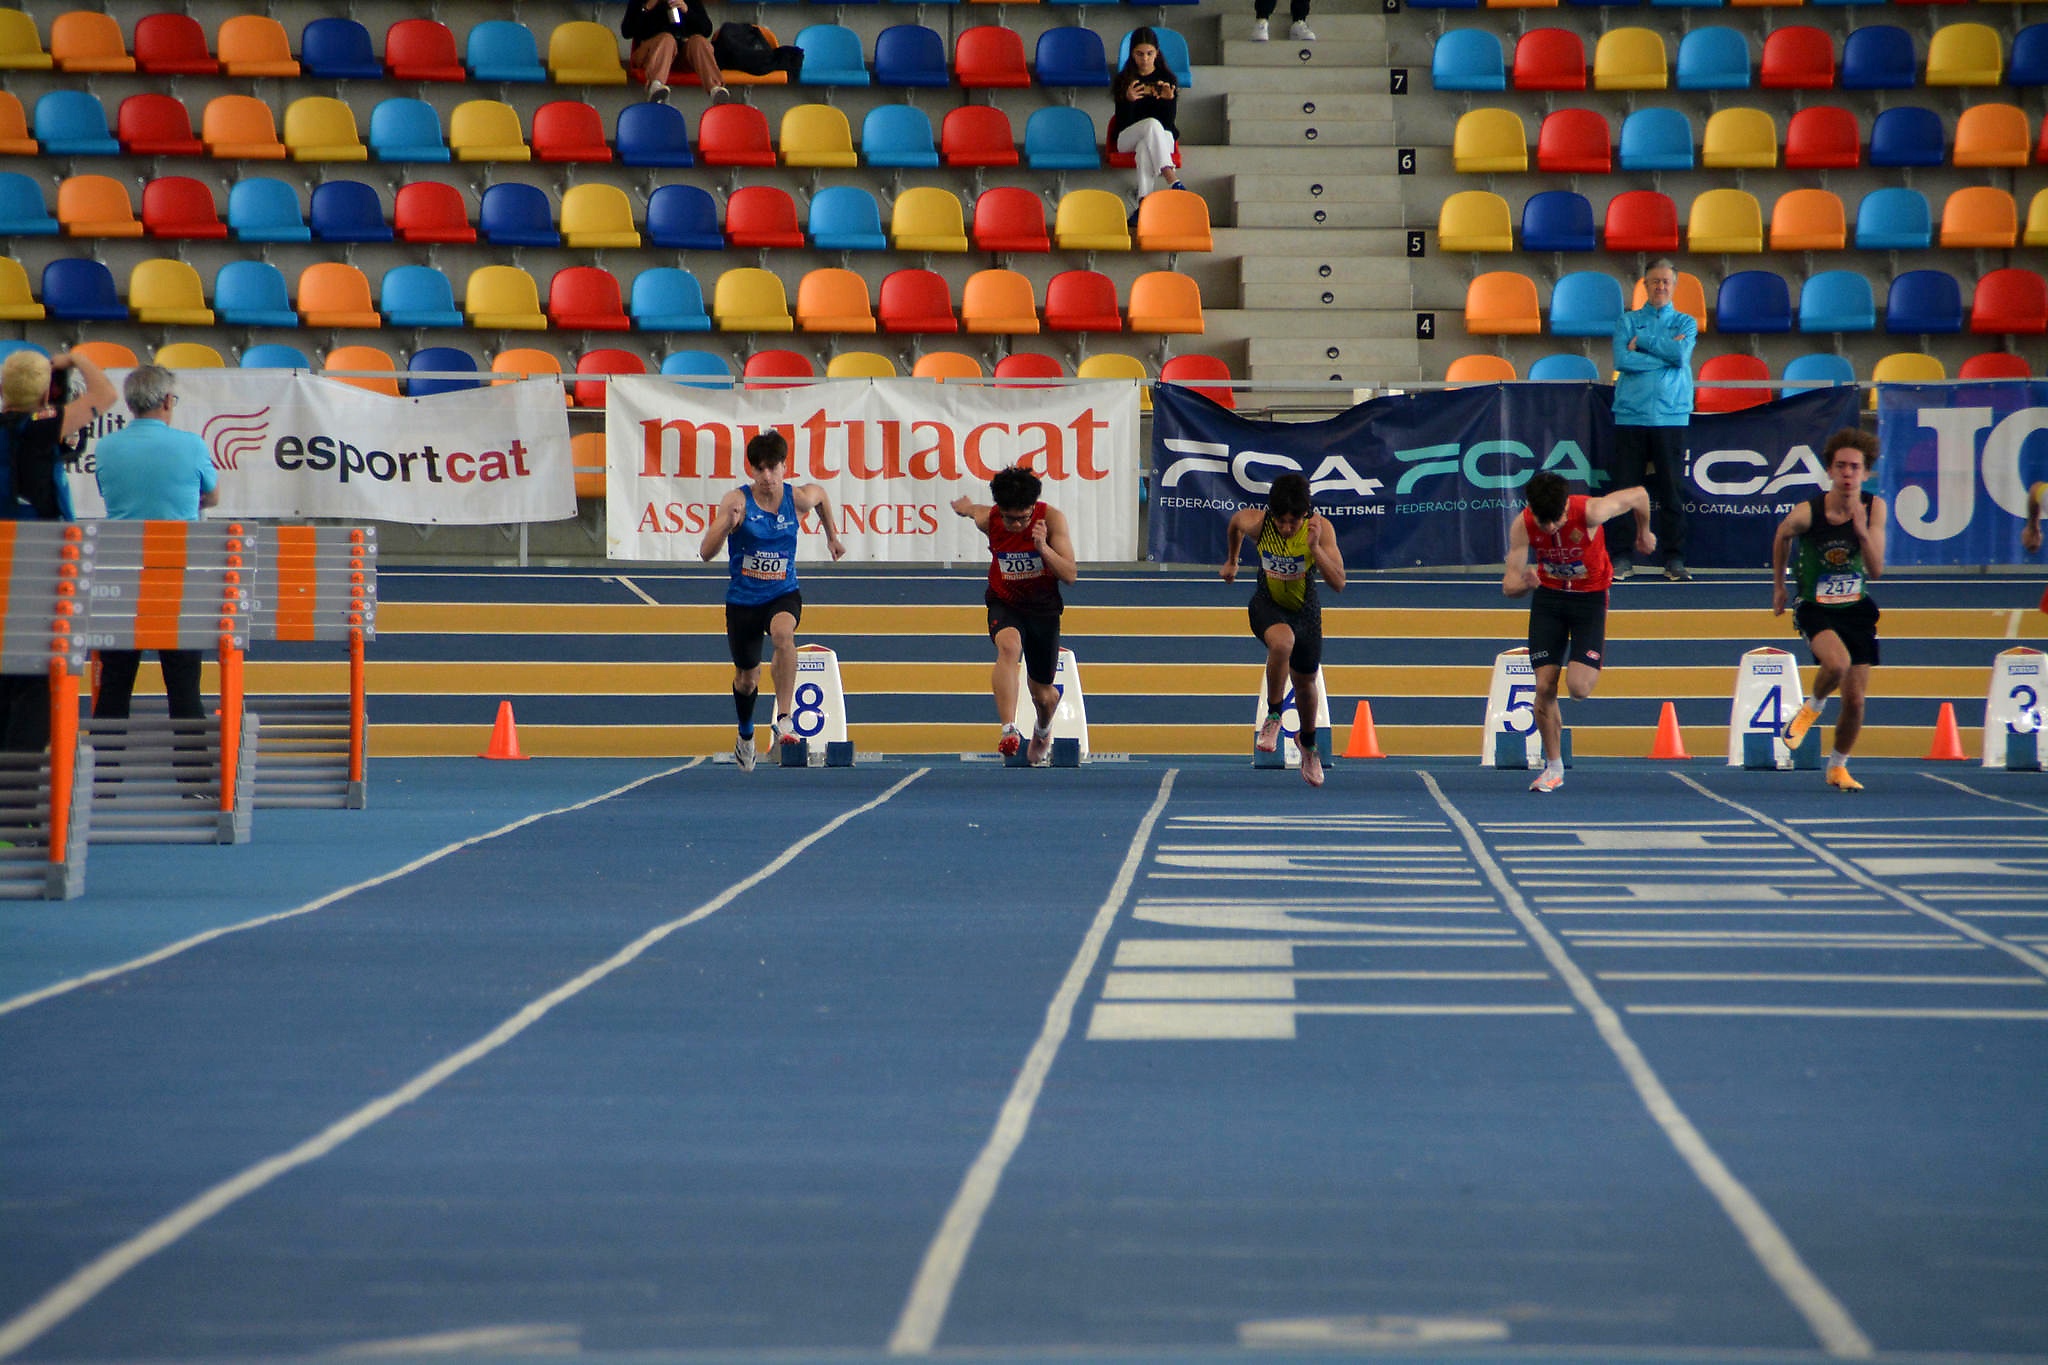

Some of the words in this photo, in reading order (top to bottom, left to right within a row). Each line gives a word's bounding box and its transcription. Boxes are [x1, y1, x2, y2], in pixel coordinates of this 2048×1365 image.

[1394, 76, 1404, 89] 7
[1402, 155, 1412, 169] 6
[1412, 238, 1421, 251] 5
[1421, 320, 1431, 333] 4
[639, 407, 1110, 481] mutuacat
[274, 435, 531, 483] esportcat
[1161, 438, 1385, 496] FCA
[1394, 440, 1612, 495] FCA
[1684, 444, 1834, 495] CA
[1160, 496, 1235, 511] FEDERACIÓ
[1312, 505, 1385, 517] ATLETISME
[1395, 500, 1467, 514] FEDERACIÓ
[1471, 498, 1529, 511] CATALAN
[1699, 503, 1771, 515] CATALANA
[751, 558, 781, 572] 360
[1006, 560, 1035, 573] 203
[1270, 560, 1298, 574] 259
[1825, 581, 1855, 595] 247
[791, 682, 825, 738] 8
[1503, 684, 1538, 737] 5
[1749, 684, 1786, 737] 4
[2005, 684, 2042, 734] 3
